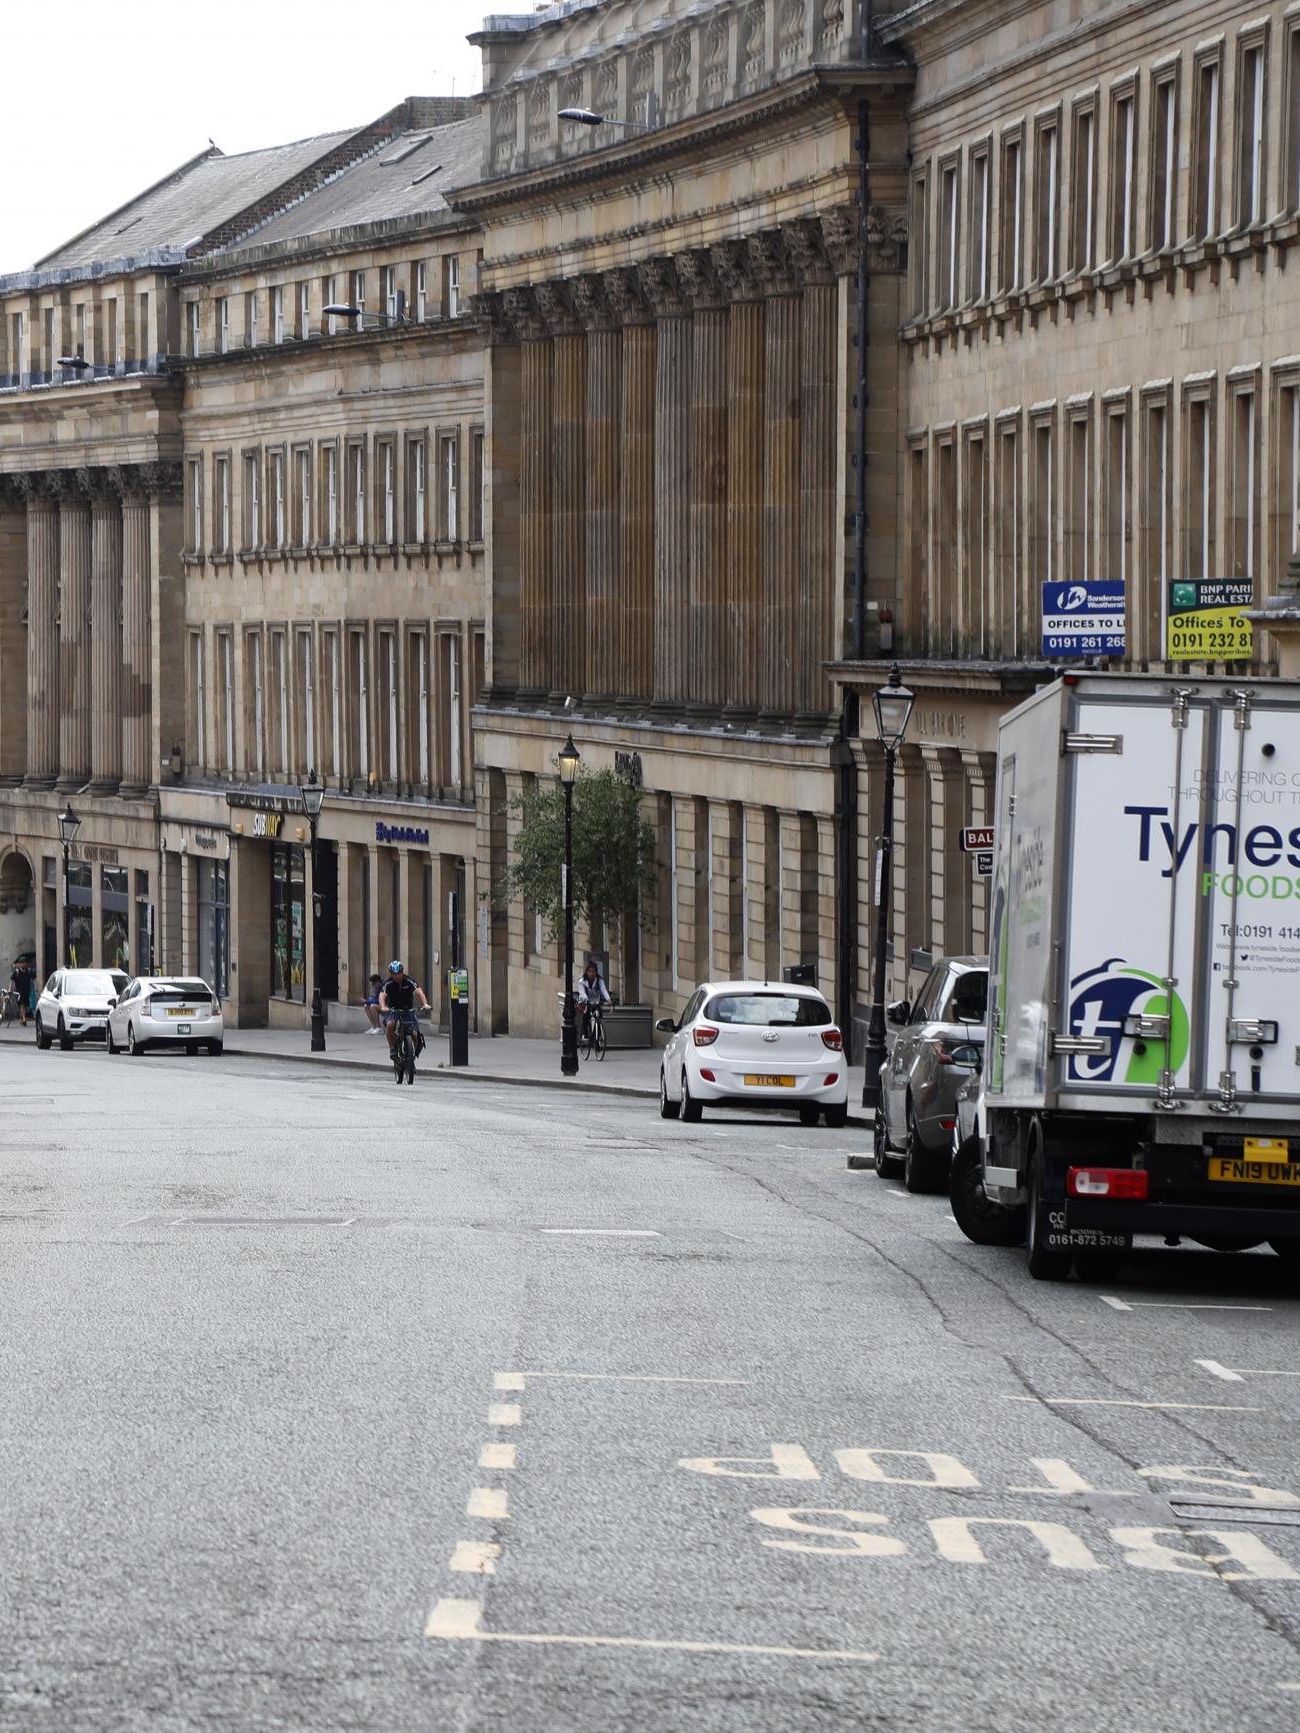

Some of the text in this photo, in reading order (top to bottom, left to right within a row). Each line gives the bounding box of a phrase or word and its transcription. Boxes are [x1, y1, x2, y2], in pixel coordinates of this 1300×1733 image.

[1200, 584, 1253, 594] BNP PARI
[1087, 594, 1126, 602] Sanderson
[1200, 595, 1228, 604] REAL
[1048, 619, 1126, 629] OFFICES TO L
[1172, 616, 1245, 629] Offices To
[1049, 637, 1077, 648] 0191
[1081, 637, 1102, 648] 261
[1172, 633, 1203, 648] 0191
[1209, 633, 1235, 647] 232
[1193, 769, 1287, 787] DELIVERING
[1167, 786, 1286, 804] THROUGHOUT
[253, 813, 281, 837] SUBWAY
[1220, 924, 1273, 938] Tel:0191
[1049, 1234, 1125, 1247] 0161-872 5749
[677, 1444, 1300, 1502] STOP
[749, 1507, 1300, 1581] BUS
